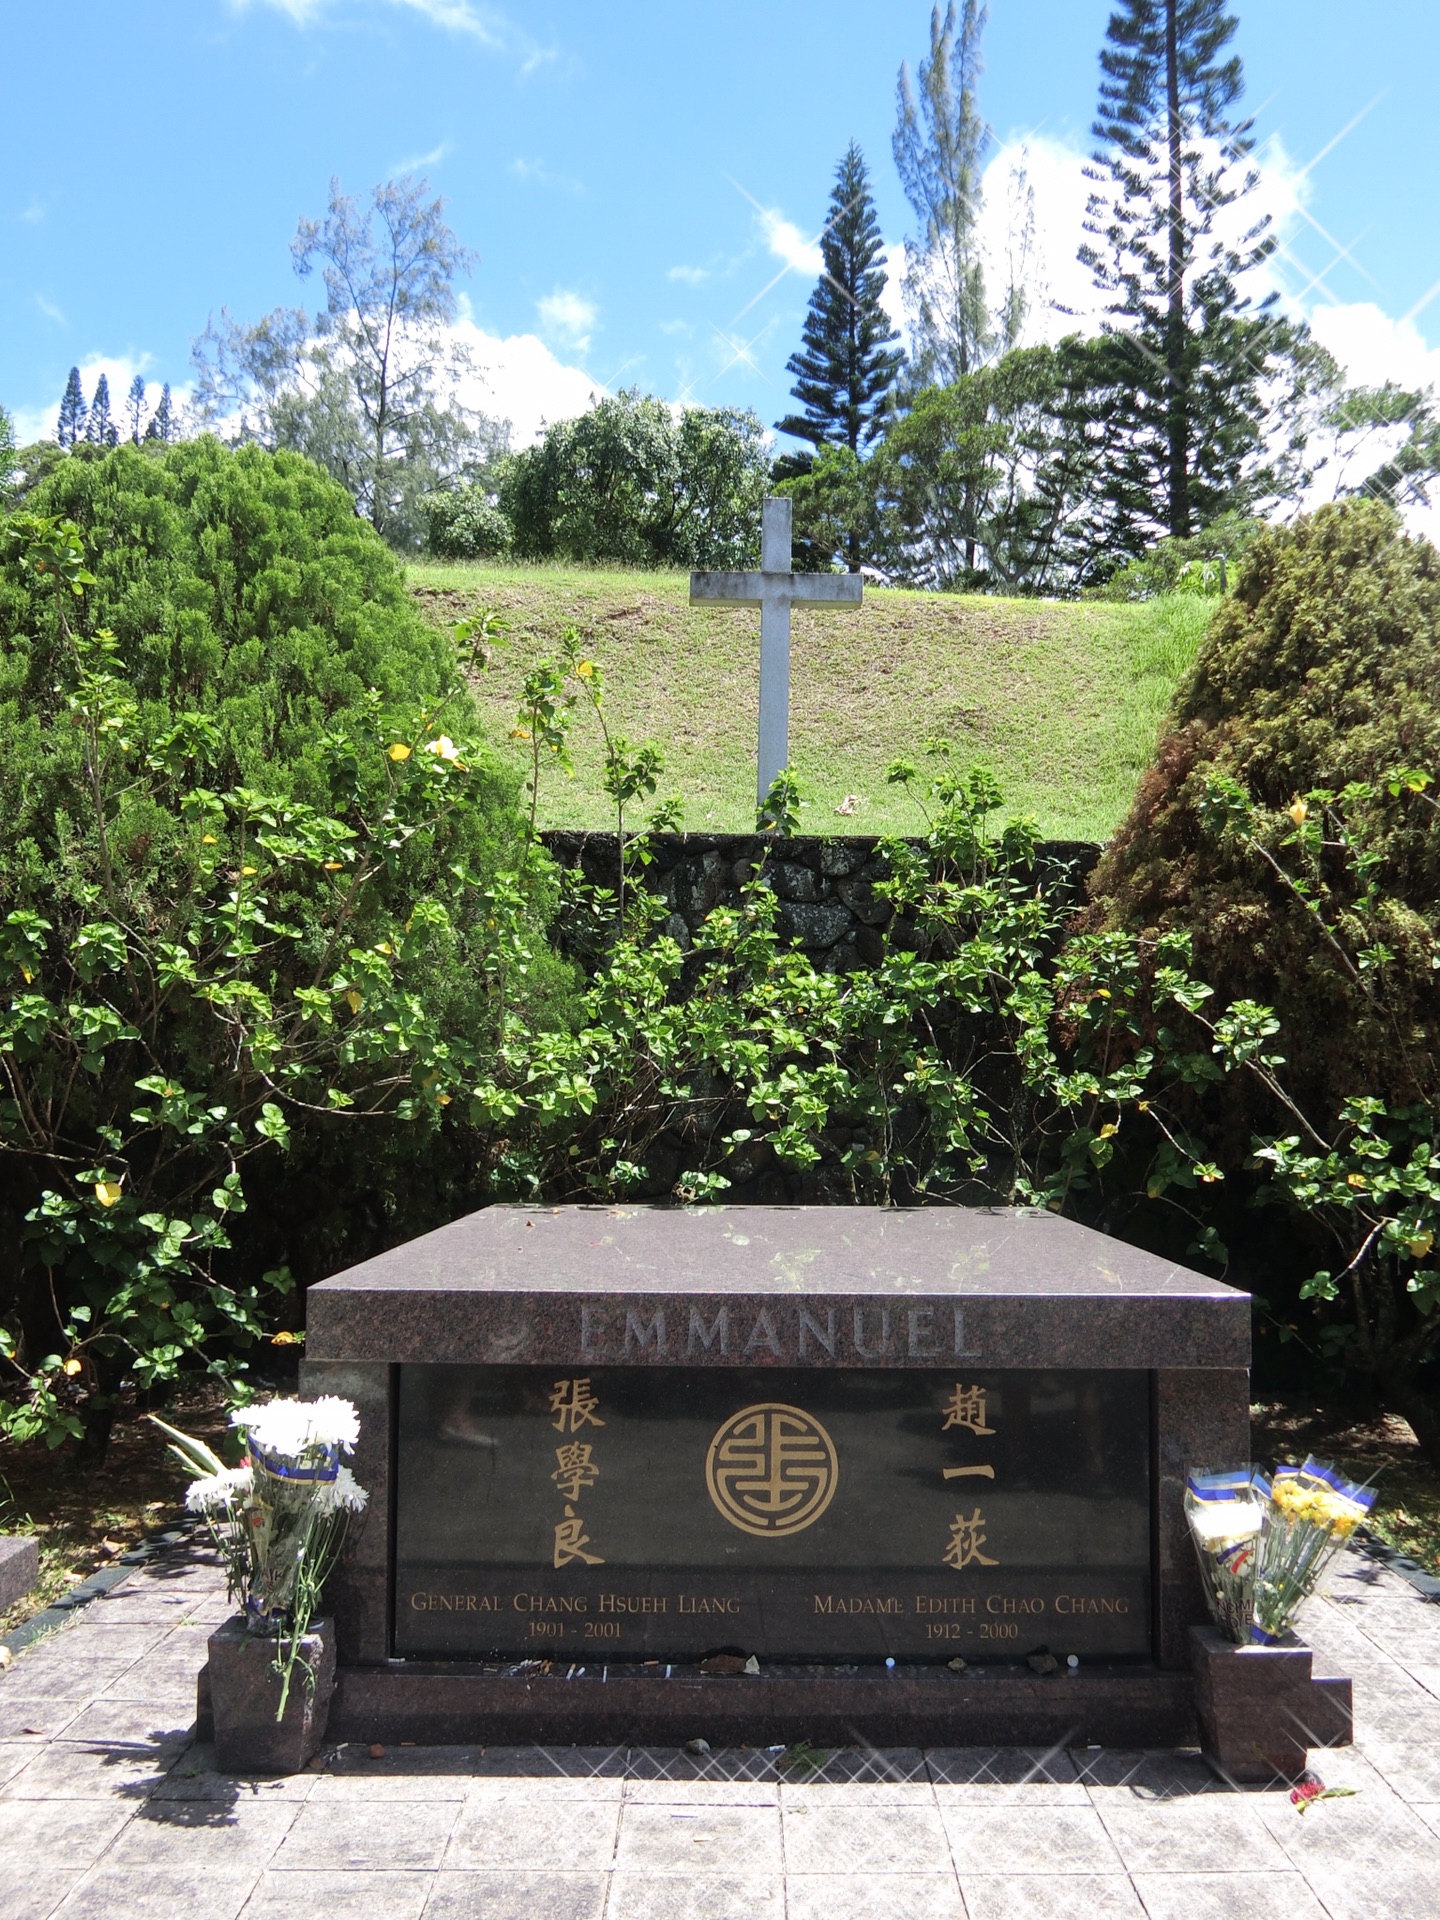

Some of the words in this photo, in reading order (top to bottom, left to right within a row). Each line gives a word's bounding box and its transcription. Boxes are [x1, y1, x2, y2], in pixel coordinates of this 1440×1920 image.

[580, 1305, 982, 1358] EMMANUEL
[549, 1378, 606, 1569] 張學良
[941, 1383, 1000, 1570] 趙一荻
[411, 1592, 503, 1612] GENERAL
[513, 1593, 588, 1614] CHANG
[599, 1593, 668, 1614] HSUEH
[678, 1594, 741, 1614] LIANG
[813, 1594, 904, 1614] MADAME
[915, 1594, 977, 1614] EDITH
[986, 1594, 1045, 1614] CHAO
[1055, 1594, 1129, 1614] CHANG
[528, 1621, 564, 1638] 1901
[584, 1621, 622, 1638] 2001
[925, 1623, 961, 1639] 1912
[979, 1623, 1019, 1639] 2000
